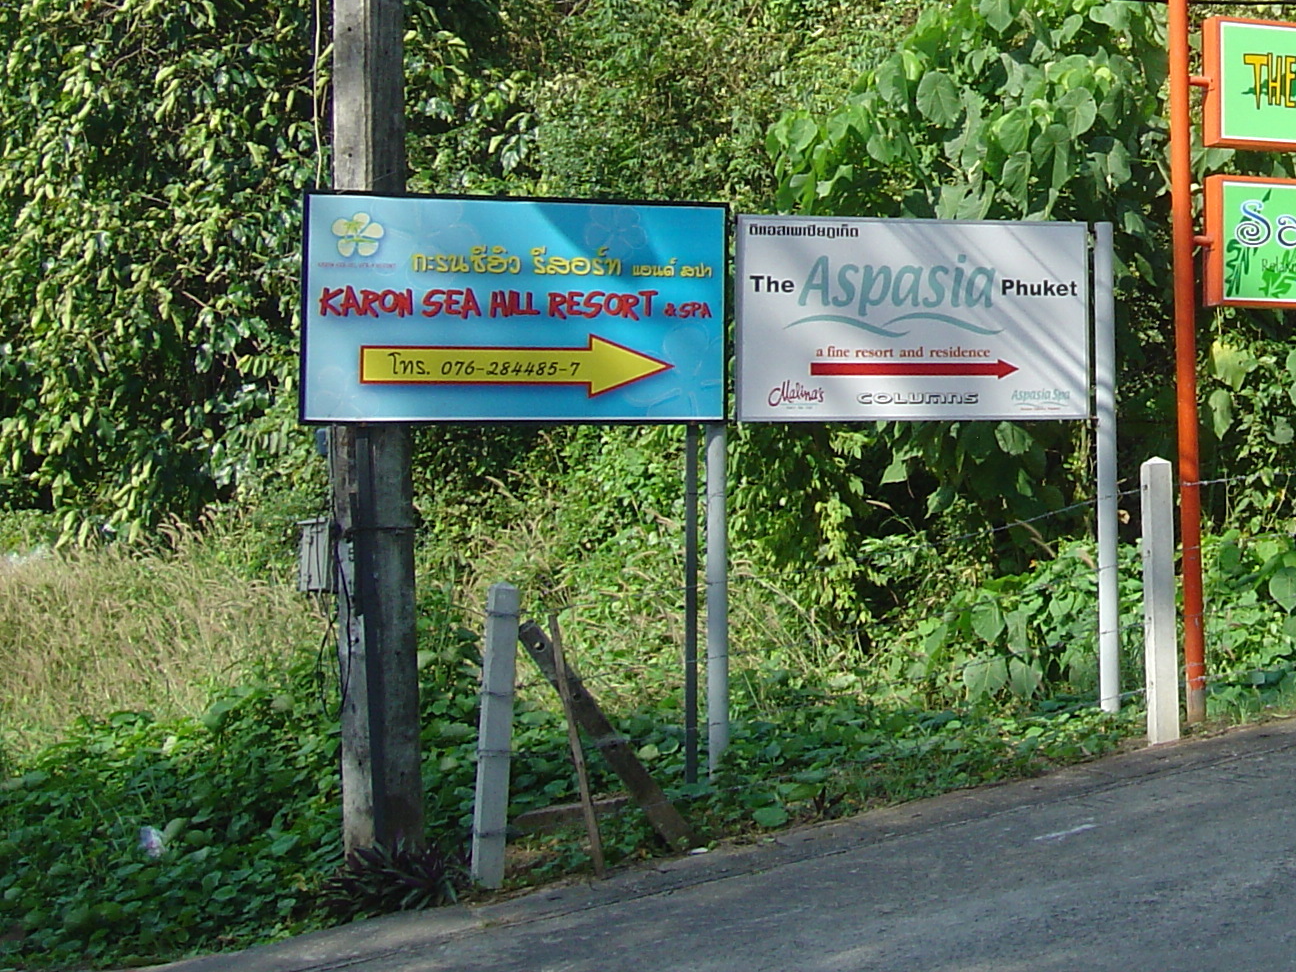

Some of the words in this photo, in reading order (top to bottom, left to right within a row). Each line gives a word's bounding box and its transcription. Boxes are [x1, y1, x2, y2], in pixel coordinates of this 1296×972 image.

[1243, 52, 1296, 109] THE
[750, 275, 795, 294] The
[798, 253, 998, 316] Aspasia
[1001, 279, 1078, 297] Phuket
[319, 284, 414, 319] KARON
[422, 287, 483, 319] SEA
[489, 289, 541, 319] HILL
[547, 290, 659, 322] RESORT
[388, 351, 430, 376] โทร.
[816, 348, 824, 358] a
[827, 345, 850, 358] fine
[855, 347, 894, 358] resort
[899, 346, 924, 358] and
[929, 346, 990, 359] residence
[441, 360, 580, 376] 076-284485-7
[768, 379, 825, 407] Malina's
[1011, 387, 1051, 403] Aspasia
[1052, 388, 1071, 402] Spa
